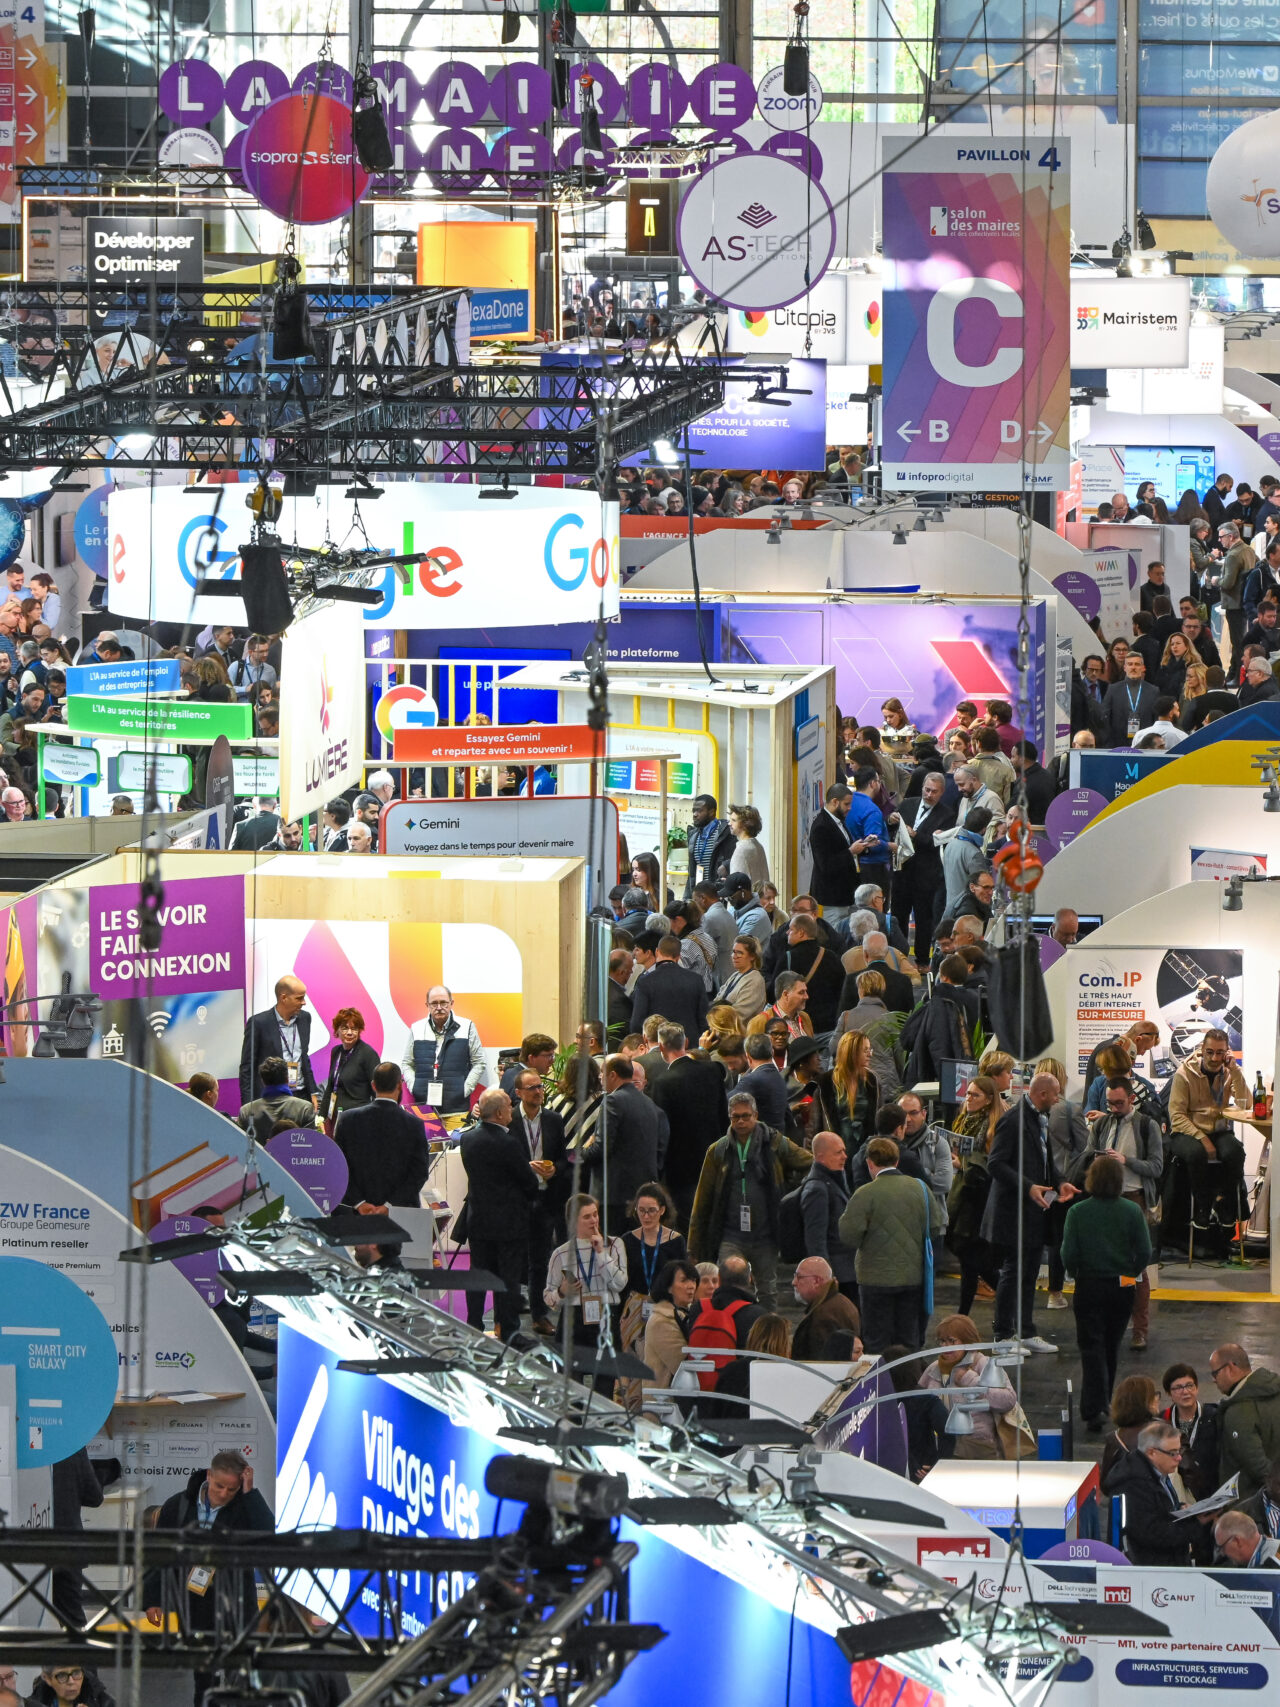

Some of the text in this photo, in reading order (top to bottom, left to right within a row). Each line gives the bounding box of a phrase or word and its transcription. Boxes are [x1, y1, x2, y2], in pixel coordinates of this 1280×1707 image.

[20, 7, 36, 23] 4
[177, 76, 273, 112] LA
[763, 97, 817, 112] zoom
[250, 151, 299, 167] sopra
[957, 146, 1062, 172] PAVILLON 4
[950, 208, 987, 219] salon
[950, 219, 1021, 232] des maires
[94, 231, 195, 252] Développer
[701, 234, 813, 262] AS-TECH
[94, 255, 182, 275] Optimiser
[774, 307, 837, 330] Citopia
[1102, 311, 1178, 326] Mairistem
[926, 277, 1025, 388] C
[691, 429, 749, 438] TECHNOLOGIE
[929, 419, 1022, 443] B D
[908, 471, 974, 483] infoprodigital
[971, 494, 1021, 502] DE GESTION
[619, 647, 680, 660] plateforme
[117, 707, 212, 720] service résilience
[134, 719, 177, 731] territoires
[465, 732, 541, 745] Essayez Gemini
[431, 744, 567, 759] et repartez avec un souvenir
[304, 738, 350, 794] LUMIÈRE
[1077, 791, 1090, 800] C57
[1071, 809, 1089, 817] AXYUS
[419, 818, 461, 830] Gemini
[403, 838, 574, 853] Voyagez dans le temps pour devenir maire
[101, 904, 207, 932] LE SVOIR
[100, 951, 231, 982] CONNEXION
[1079, 990, 1133, 1000] LE TRÈS HAUT
[1079, 999, 1102, 1008] DÉBIT
[1077, 1011, 1144, 1020] SUR-MESURE
[290, 1132, 306, 1143] C74
[291, 1156, 326, 1167] CLARANET
[0, 1203, 91, 1220] ZW France
[0, 1219, 91, 1232] Groupe Geomesure
[174, 1220, 191, 1232] C76
[2, 1237, 89, 1249] Platinum reseller
[65, 1261, 101, 1271] Premium
[28, 1343, 87, 1358] SMART CITY
[28, 1357, 67, 1371] GALAXY
[362, 1409, 480, 1540] Village des
[1069, 1545, 1091, 1559] D80
[1105, 1588, 1196, 1603] mti CANUT
[1117, 1639, 1261, 1653] MTI, votre partenaire CANUT
[1131, 1663, 1250, 1676] INFRASTRUCTURES, SERVEURS
[1163, 1674, 1218, 1685] ET STOCKAGE
